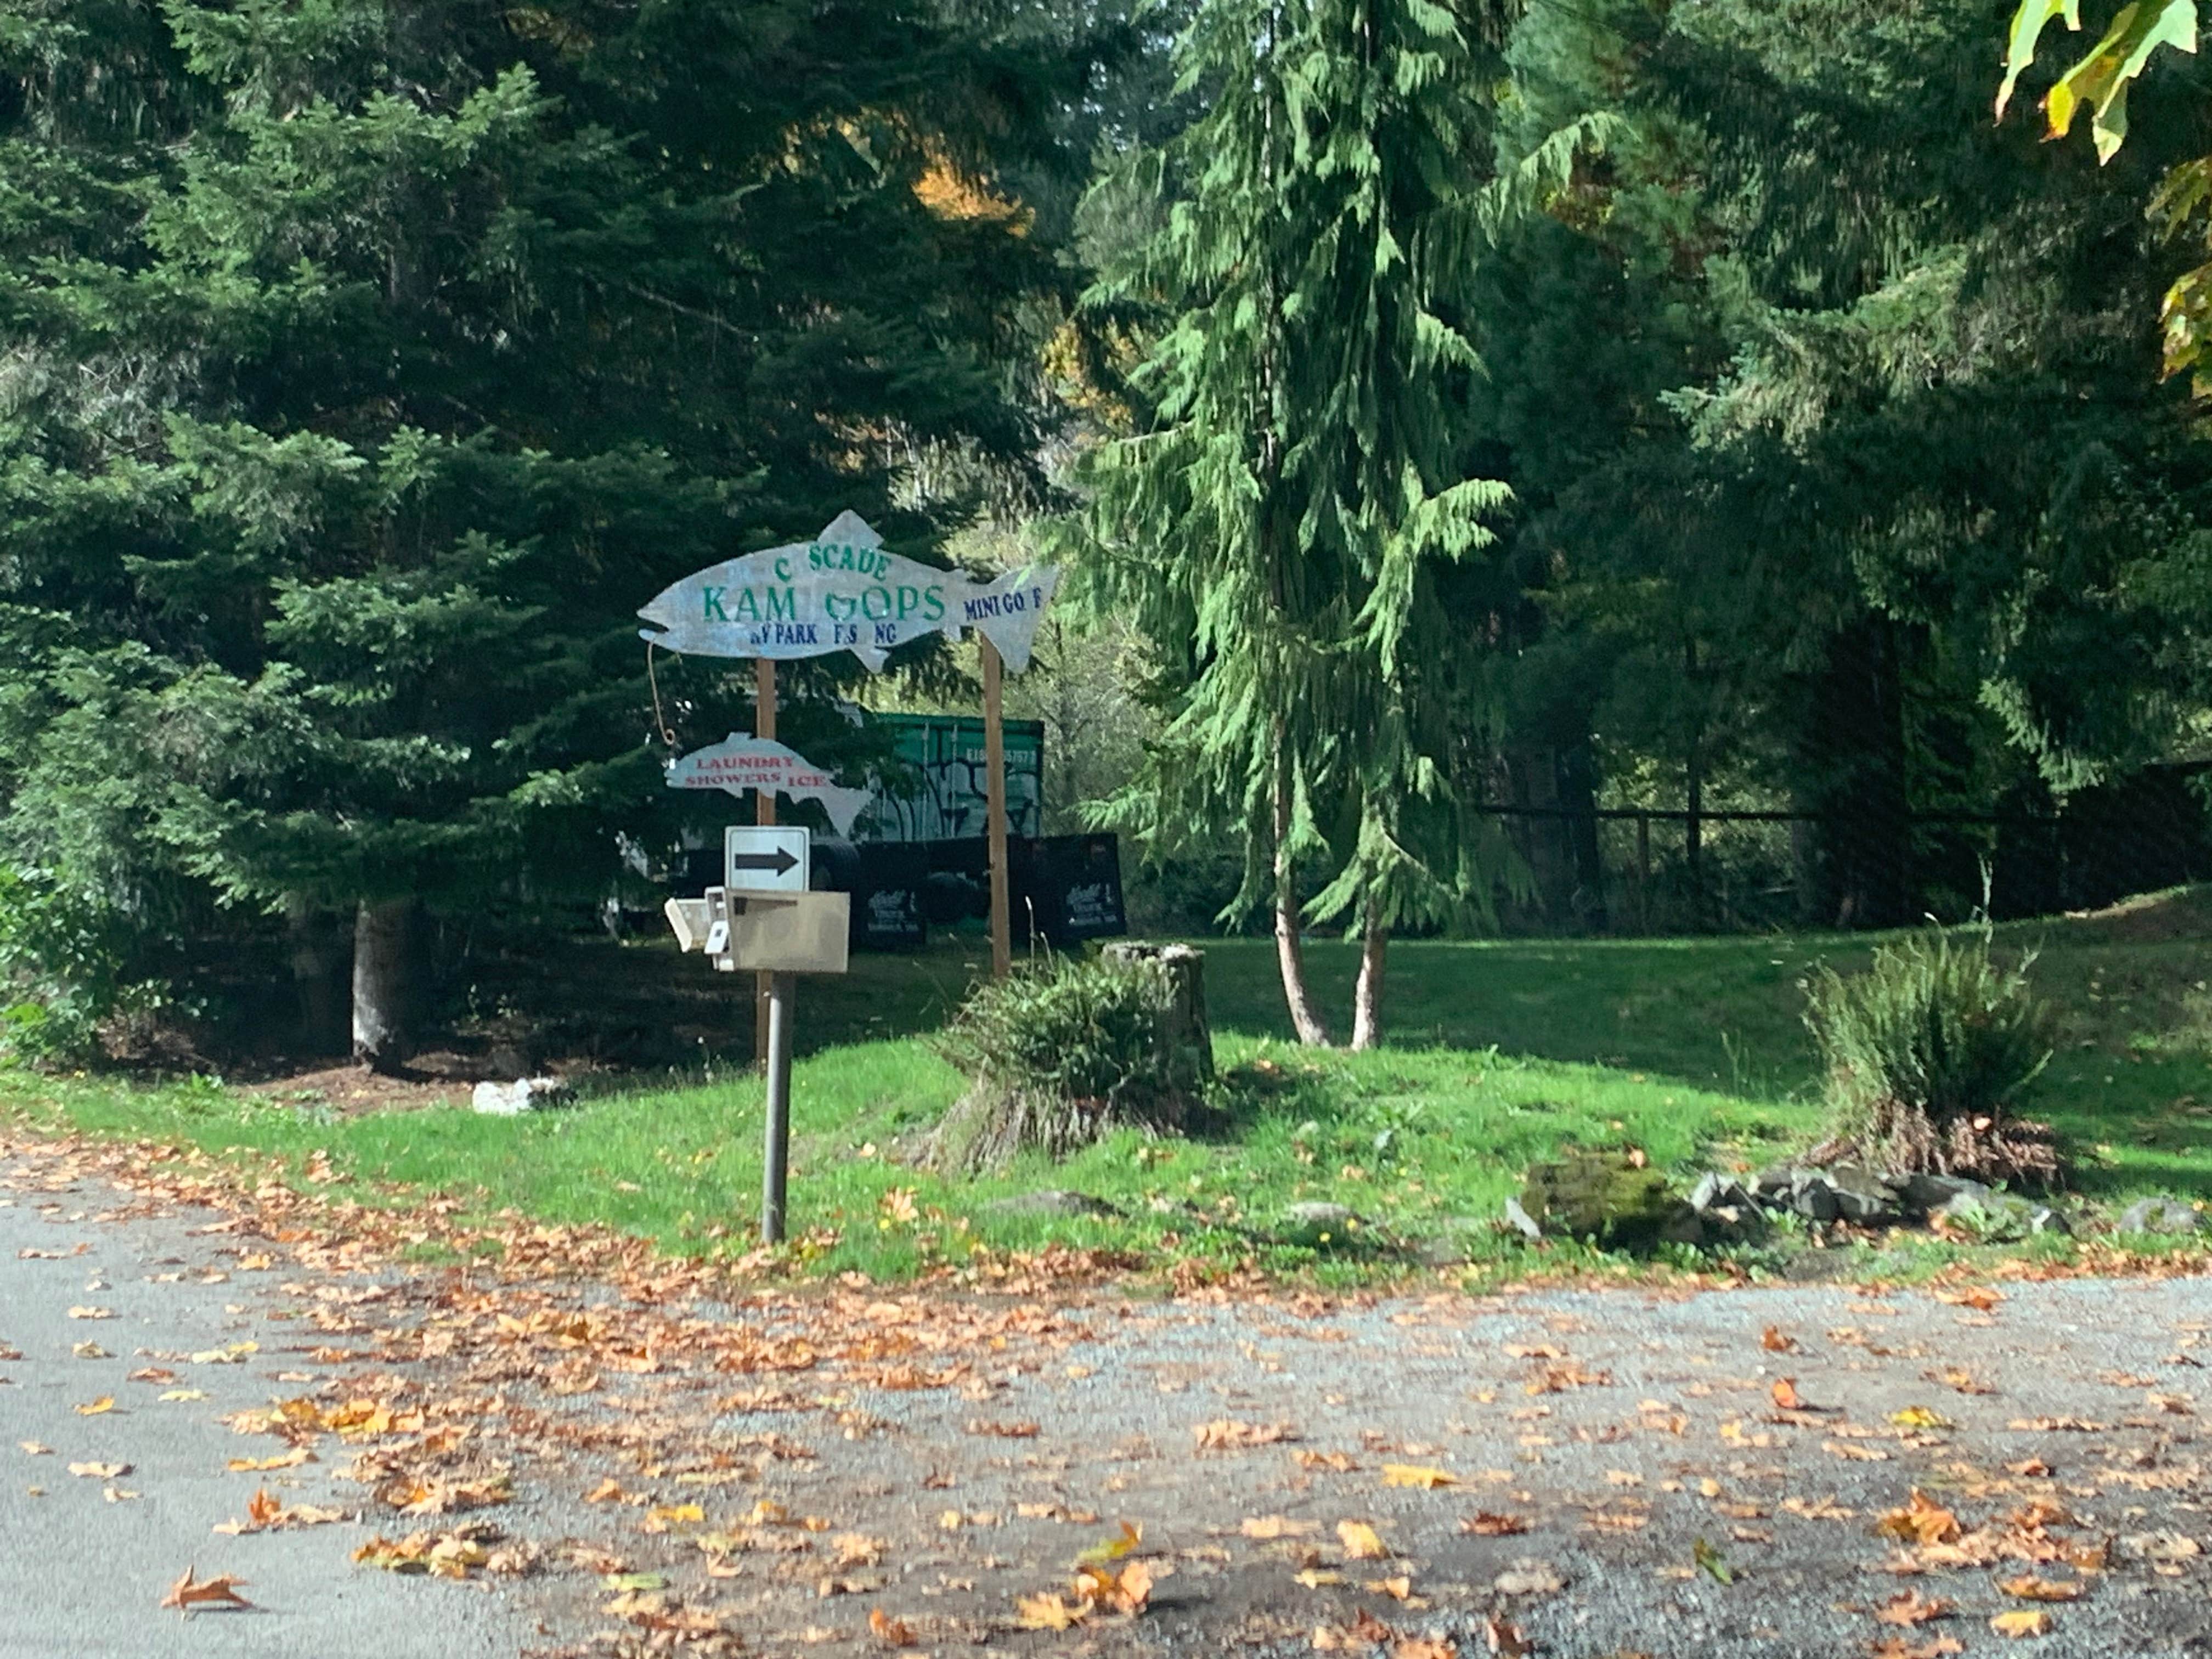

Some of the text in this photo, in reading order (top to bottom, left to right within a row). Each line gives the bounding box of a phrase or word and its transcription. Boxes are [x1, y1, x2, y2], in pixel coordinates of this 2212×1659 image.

[774, 543, 891, 583] CSCADE
[703, 585, 945, 622] KAMOOPS
[964, 586, 1042, 621] MINI GOF
[775, 623, 818, 645] PARK
[696, 756, 794, 771] LAUNDRY
[685, 772, 826, 787] SHOWERS ICE
